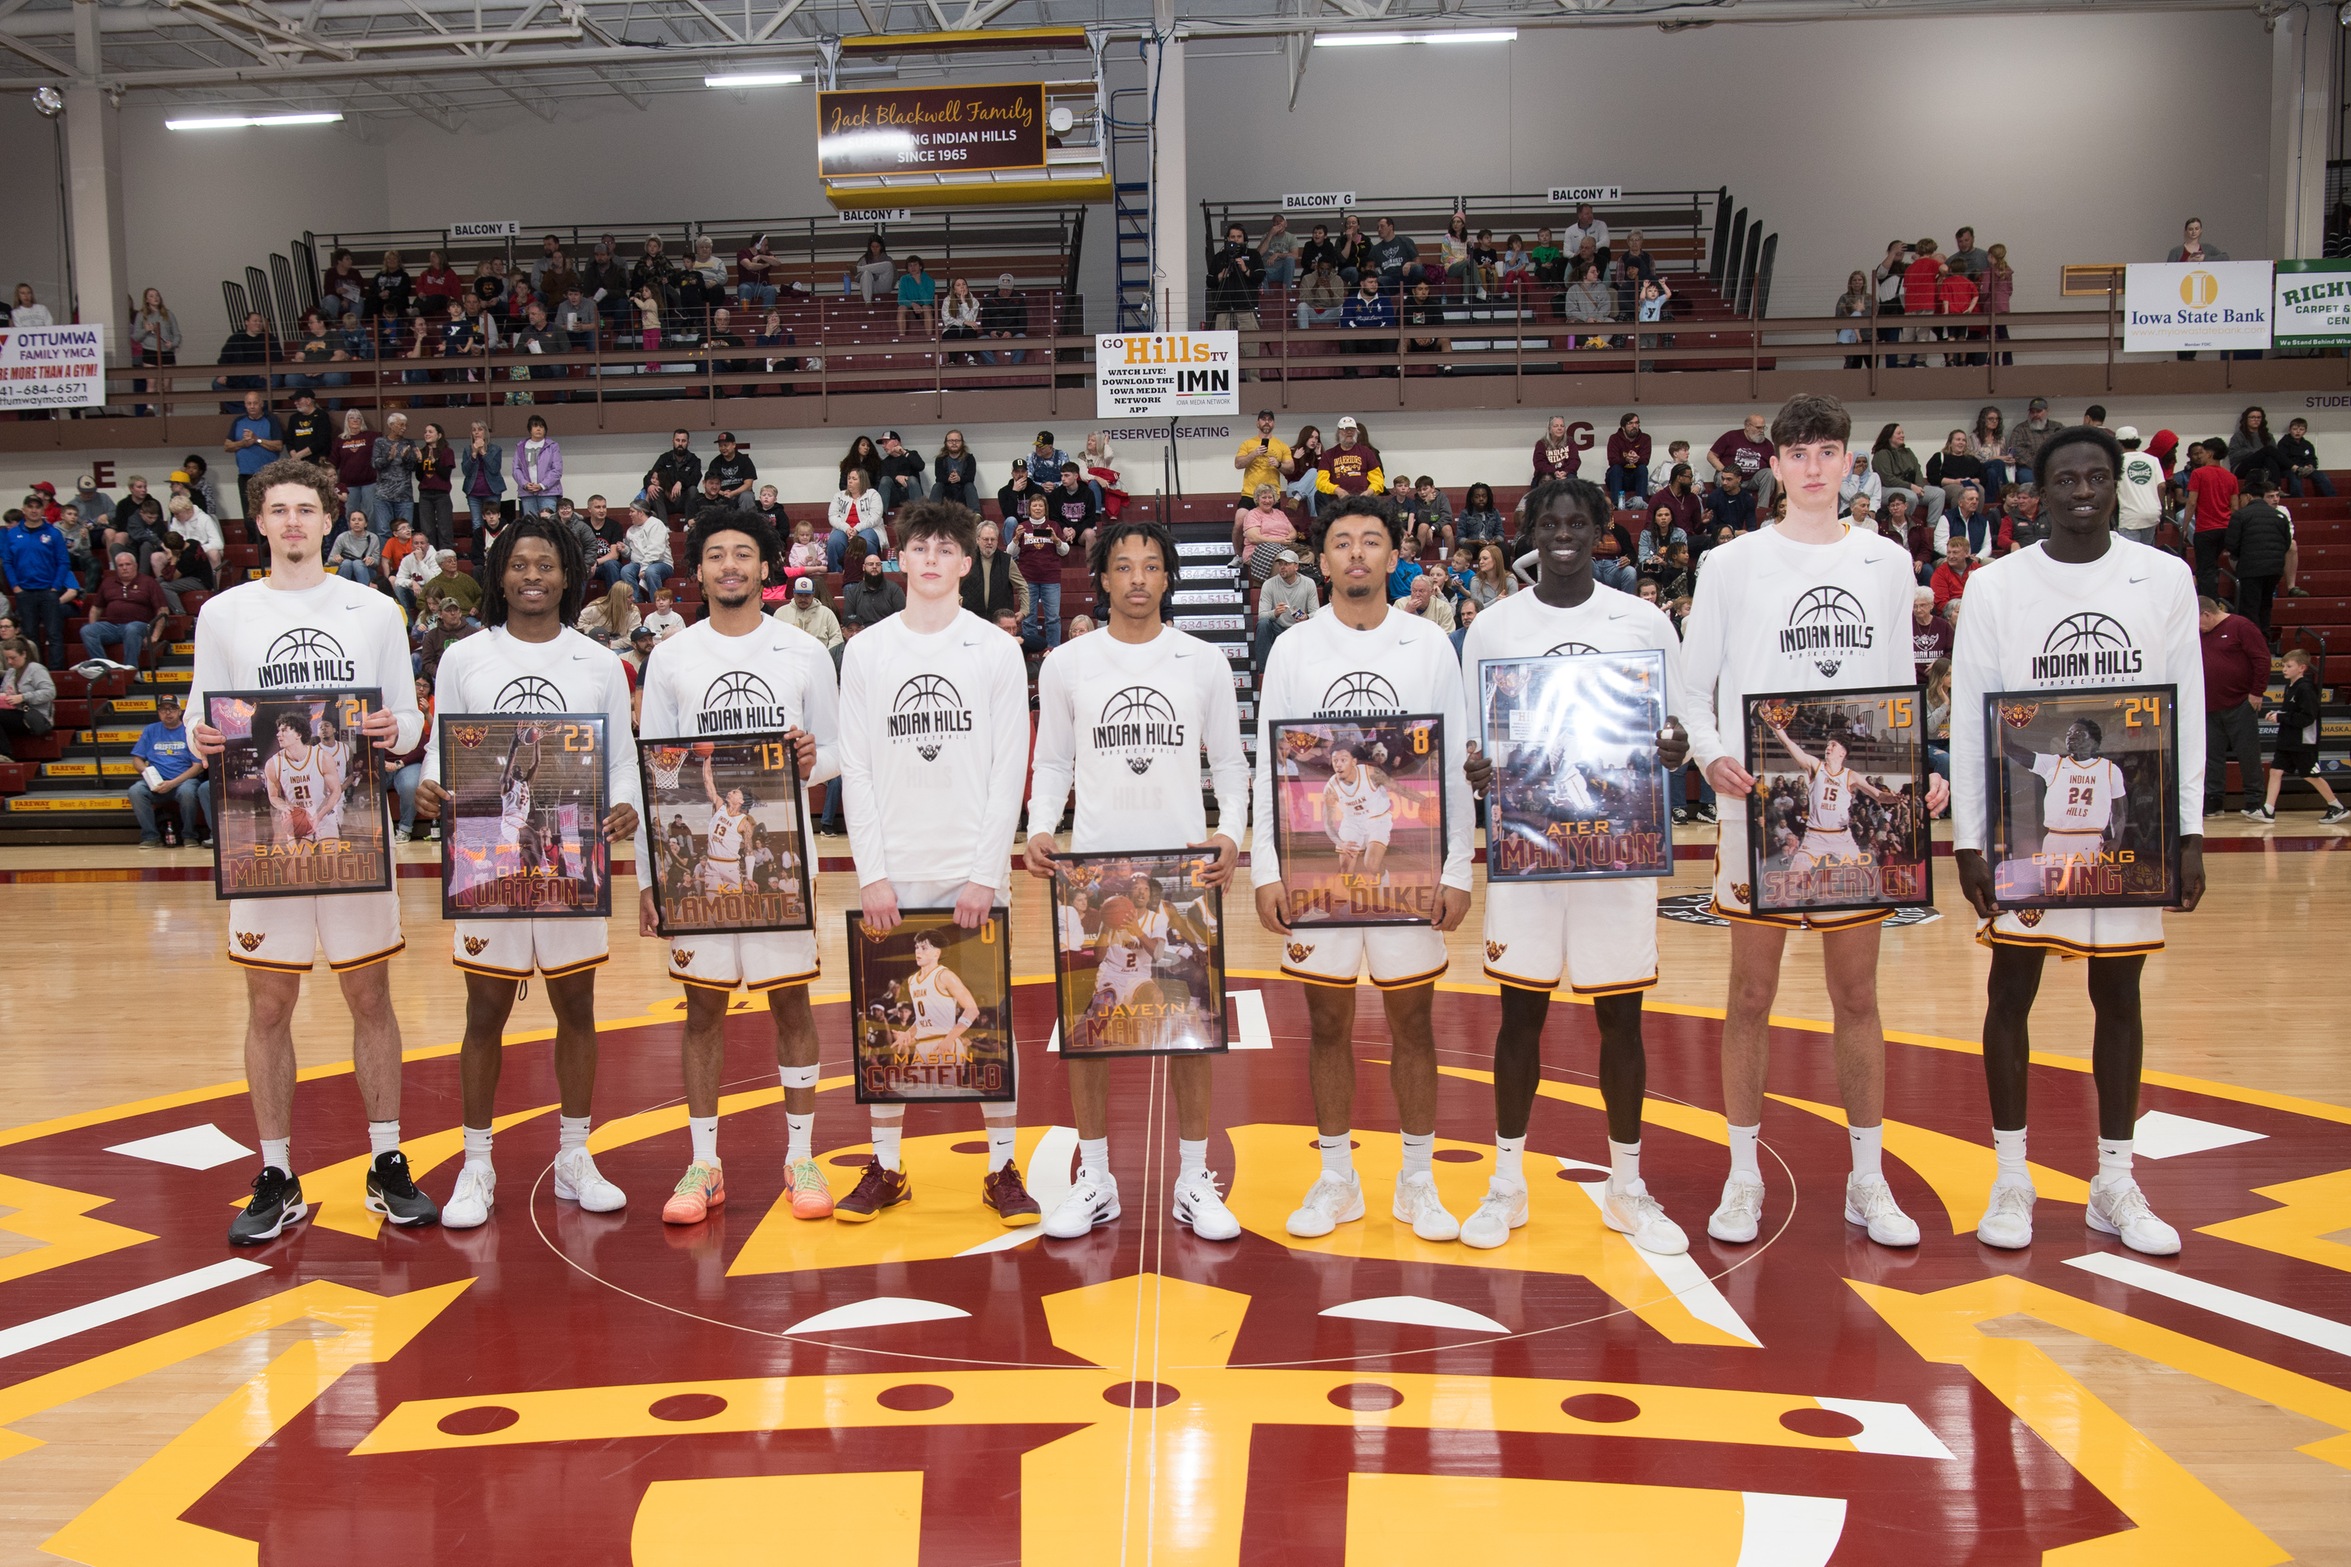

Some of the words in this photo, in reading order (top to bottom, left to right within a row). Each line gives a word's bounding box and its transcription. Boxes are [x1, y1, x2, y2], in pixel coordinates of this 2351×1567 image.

[831, 104, 871, 134] Jack
[876, 99, 962, 126] Blackwell
[966, 96, 1033, 127] Family
[932, 131, 978, 145] INDIAN
[981, 129, 1017, 143] HILLS
[897, 150, 935, 163] SINCE
[938, 149, 967, 161] 1965
[1286, 195, 1338, 207] BALCONY
[1343, 194, 1351, 205] G
[1552, 188, 1604, 200] BALCONY
[1610, 187, 1618, 199] H
[843, 210, 892, 221] BALCONY
[899, 209, 905, 219] F
[454, 223, 502, 236] BALCONY
[509, 223, 516, 233] E
[2131, 310, 2172, 325] Iowa
[2177, 309, 2218, 324] State
[2223, 307, 2265, 323] Bank
[2295, 305, 2339, 314] CARPET
[2343, 304, 2351, 313] &
[2327, 316, 2350, 325] CEN
[17, 331, 97, 347] OTTUMWA
[2131, 326, 2266, 337] www.myiowastatebank.com
[20, 349, 60, 360] FAMILY
[62, 347, 95, 358] YMCA
[1102, 338, 1123, 349] GO
[1123, 336, 1211, 364] Hills
[1210, 351, 1228, 362] TV
[10, 366, 37, 380] MORE
[38, 365, 63, 379] THAN
[64, 364, 71, 378] A
[73, 363, 98, 377] GYM!
[1102, 378, 1155, 386] DOWNLOAD
[1177, 369, 1229, 392] IMN
[1114, 396, 1161, 404] NETWORK
[1129, 406, 1148, 414] APP
[1102, 428, 1170, 440] RESERVED
[1175, 426, 1229, 438] SEATING
[1566, 421, 1594, 451] G
[1333, 455, 1362, 466] WARRIORS
[1547, 452, 1569, 463] HILLS
[93, 461, 117, 488] E
[1180, 546, 1233, 555] 684-5151
[1180, 594, 1237, 604] 684-5151
[1180, 620, 1238, 630] 684-5151
[1779, 625, 1830, 653] INDIAN
[1834, 625, 1874, 649] HILLS
[1929, 650, 1944, 658] HILLS
[2032, 652, 2089, 680] INDIAN
[2095, 650, 2142, 675] HILLS
[258, 661, 310, 688] INDIAN
[313, 659, 354, 682] HILLS
[2040, 676, 2135, 687] BASKETBALL
[1877, 697, 1912, 729] #15
[2114, 697, 2160, 727] #24
[697, 708, 742, 734] INDIAN
[746, 706, 785, 728] HILLS
[887, 712, 930, 738] INDIAN
[934, 710, 972, 732] HILLS
[1093, 723, 1141, 749] INDIAN
[1146, 723, 1185, 747] HILLS
[753, 743, 785, 771] #13
[289, 774, 311, 784] INDIAN
[2069, 774, 2096, 785] INDIAN
[293, 785, 310, 799] 21
[1823, 787, 1838, 802] 15
[2068, 787, 2093, 806] 24
[2066, 807, 2088, 817] HILLS
[713, 823, 727, 837] 13
[1546, 820, 1609, 835] ATER
[254, 841, 352, 857] SAWYER
[1501, 832, 1657, 870] MANYUON
[1809, 853, 1873, 868] VLAD
[2031, 850, 2135, 866] CHAING
[228, 852, 377, 888] MAYHUGH
[496, 864, 559, 878] CHAZ
[1341, 872, 1381, 886] TAJ
[1763, 864, 1918, 902] SEMERYCH
[2044, 864, 2122, 896] RING
[474, 878, 579, 906] WATSON
[717, 883, 743, 895] KJ
[665, 892, 800, 925] LAMONTE
[1290, 885, 1433, 917] AU-DUKE
[1126, 953, 1137, 968] 2
[917, 1000, 925, 1017] 0
[1098, 1003, 1185, 1017] JAVEYN
[894, 1051, 974, 1065] MASON
[866, 1063, 1002, 1093] COSTELLO
